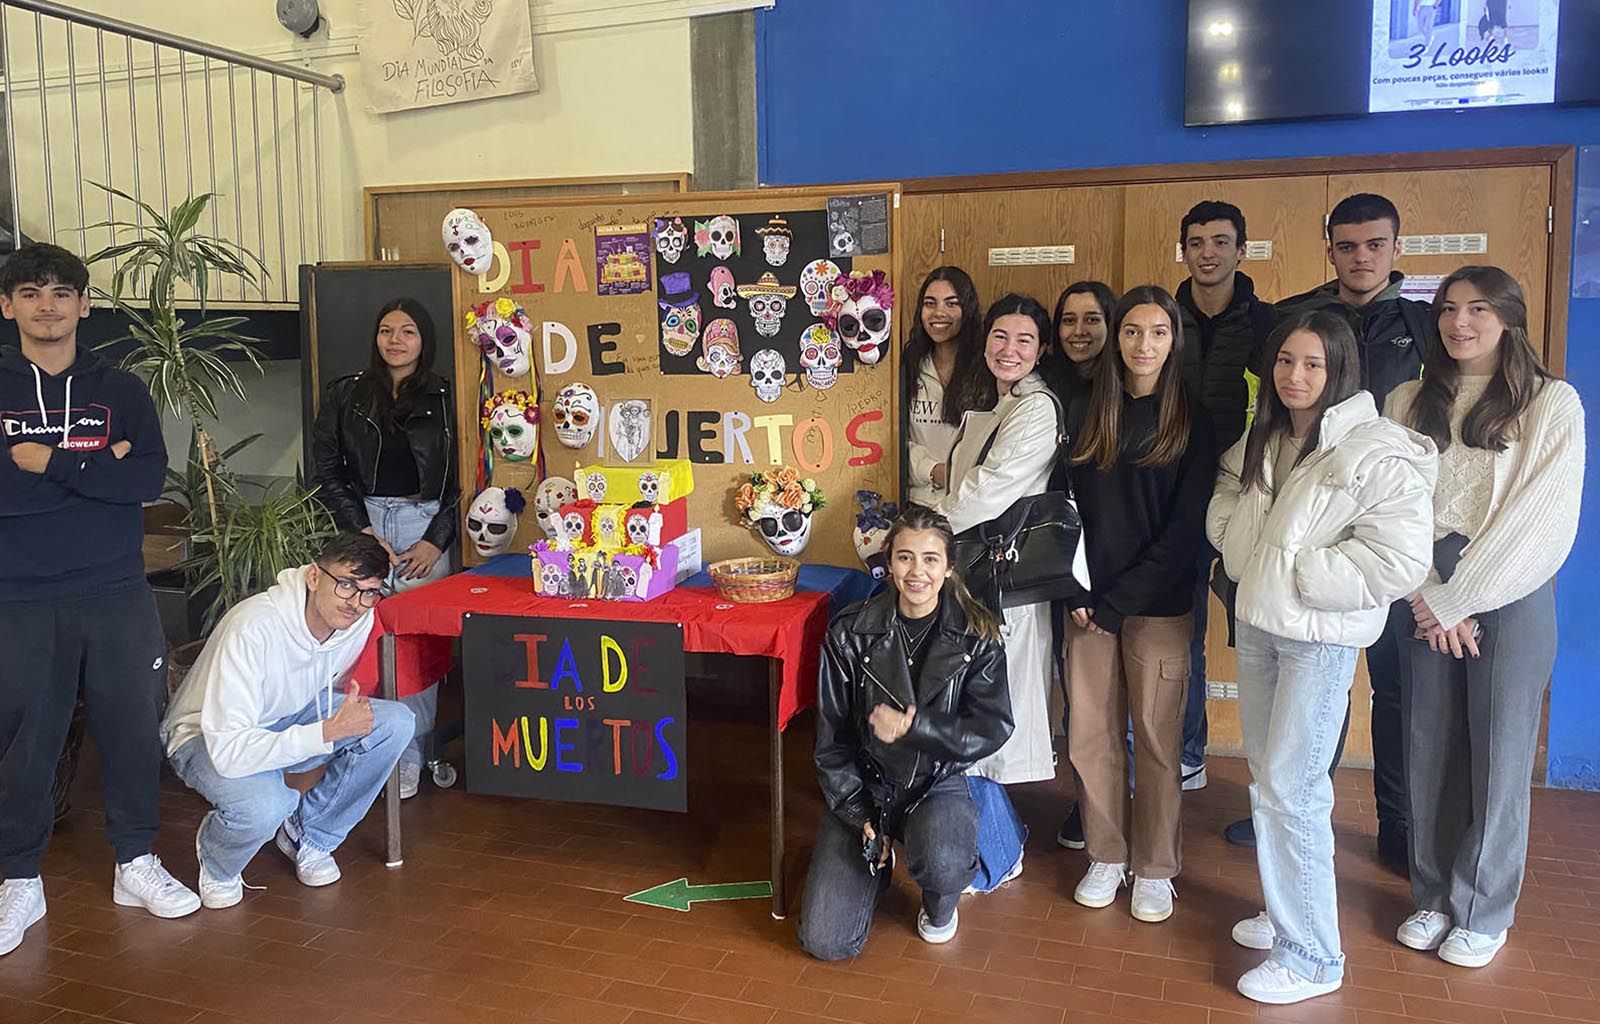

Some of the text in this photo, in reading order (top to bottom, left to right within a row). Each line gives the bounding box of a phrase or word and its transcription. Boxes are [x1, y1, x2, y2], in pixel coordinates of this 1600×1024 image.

[414, 56, 480, 78] MUNDIAL
[1403, 39, 1516, 69] 3 Looks
[1373, 77, 1391, 85] Com
[1392, 75, 1421, 85] poucas
[1423, 73, 1448, 83] peças,
[1450, 70, 1494, 81] consegues
[1495, 68, 1521, 78] vários
[1522, 67, 1549, 76] looks!
[478, 239, 589, 294] DIA
[543, 321, 626, 376] DE
[3, 418, 104, 436] Chamon
[601, 635, 659, 697] DE
[564, 695, 596, 711] LOS
